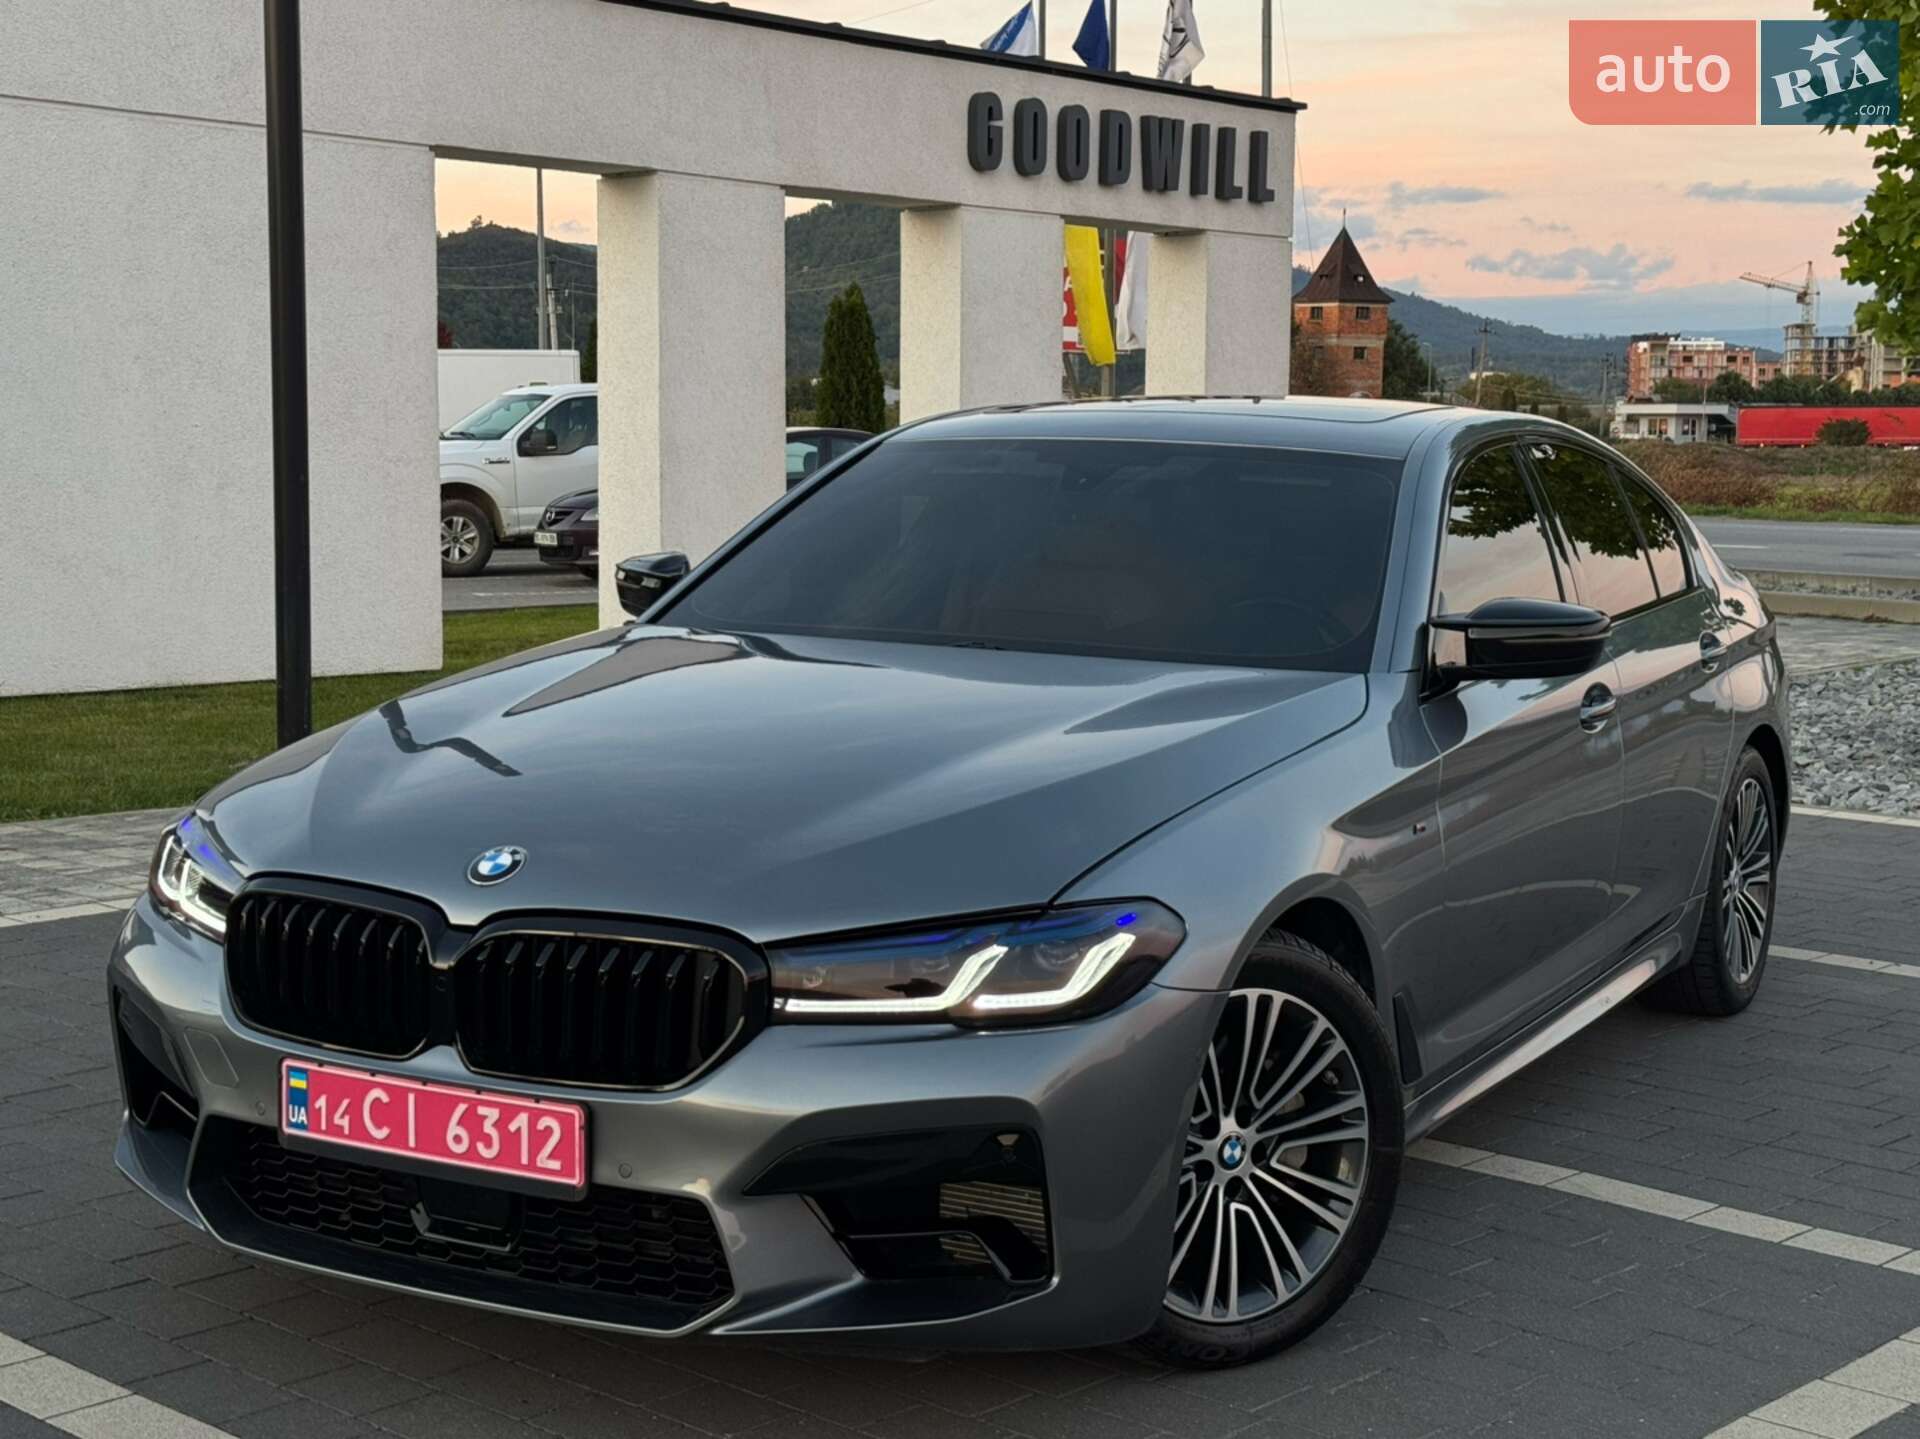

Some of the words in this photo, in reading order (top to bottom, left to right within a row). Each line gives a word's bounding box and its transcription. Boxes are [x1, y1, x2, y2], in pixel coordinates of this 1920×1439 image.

[967, 91, 1275, 203] GOODWILL
[288, 1104, 308, 1125] UA
[446, 1103, 562, 1171] 6312
